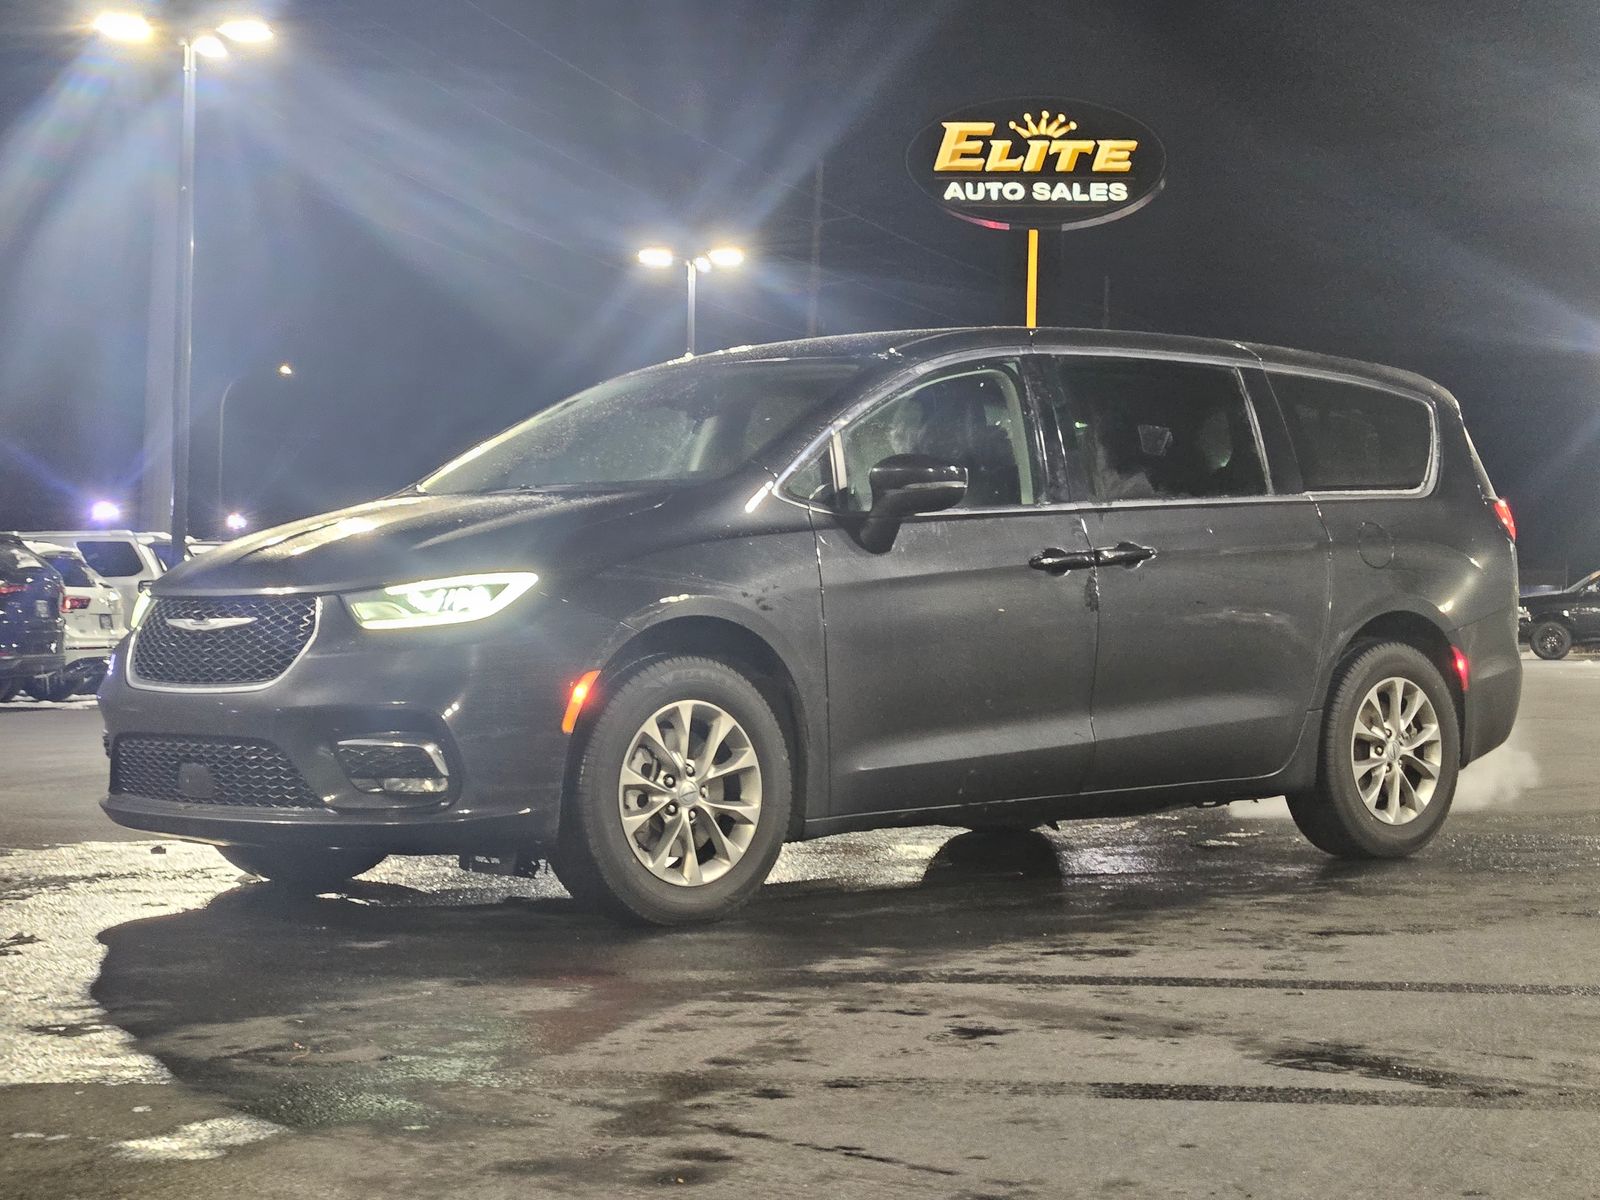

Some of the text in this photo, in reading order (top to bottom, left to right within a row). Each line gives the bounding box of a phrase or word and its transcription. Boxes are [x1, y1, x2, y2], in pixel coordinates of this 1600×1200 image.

[934, 122, 1138, 172] ELITE
[943, 182, 1129, 202] AUTO SALES
